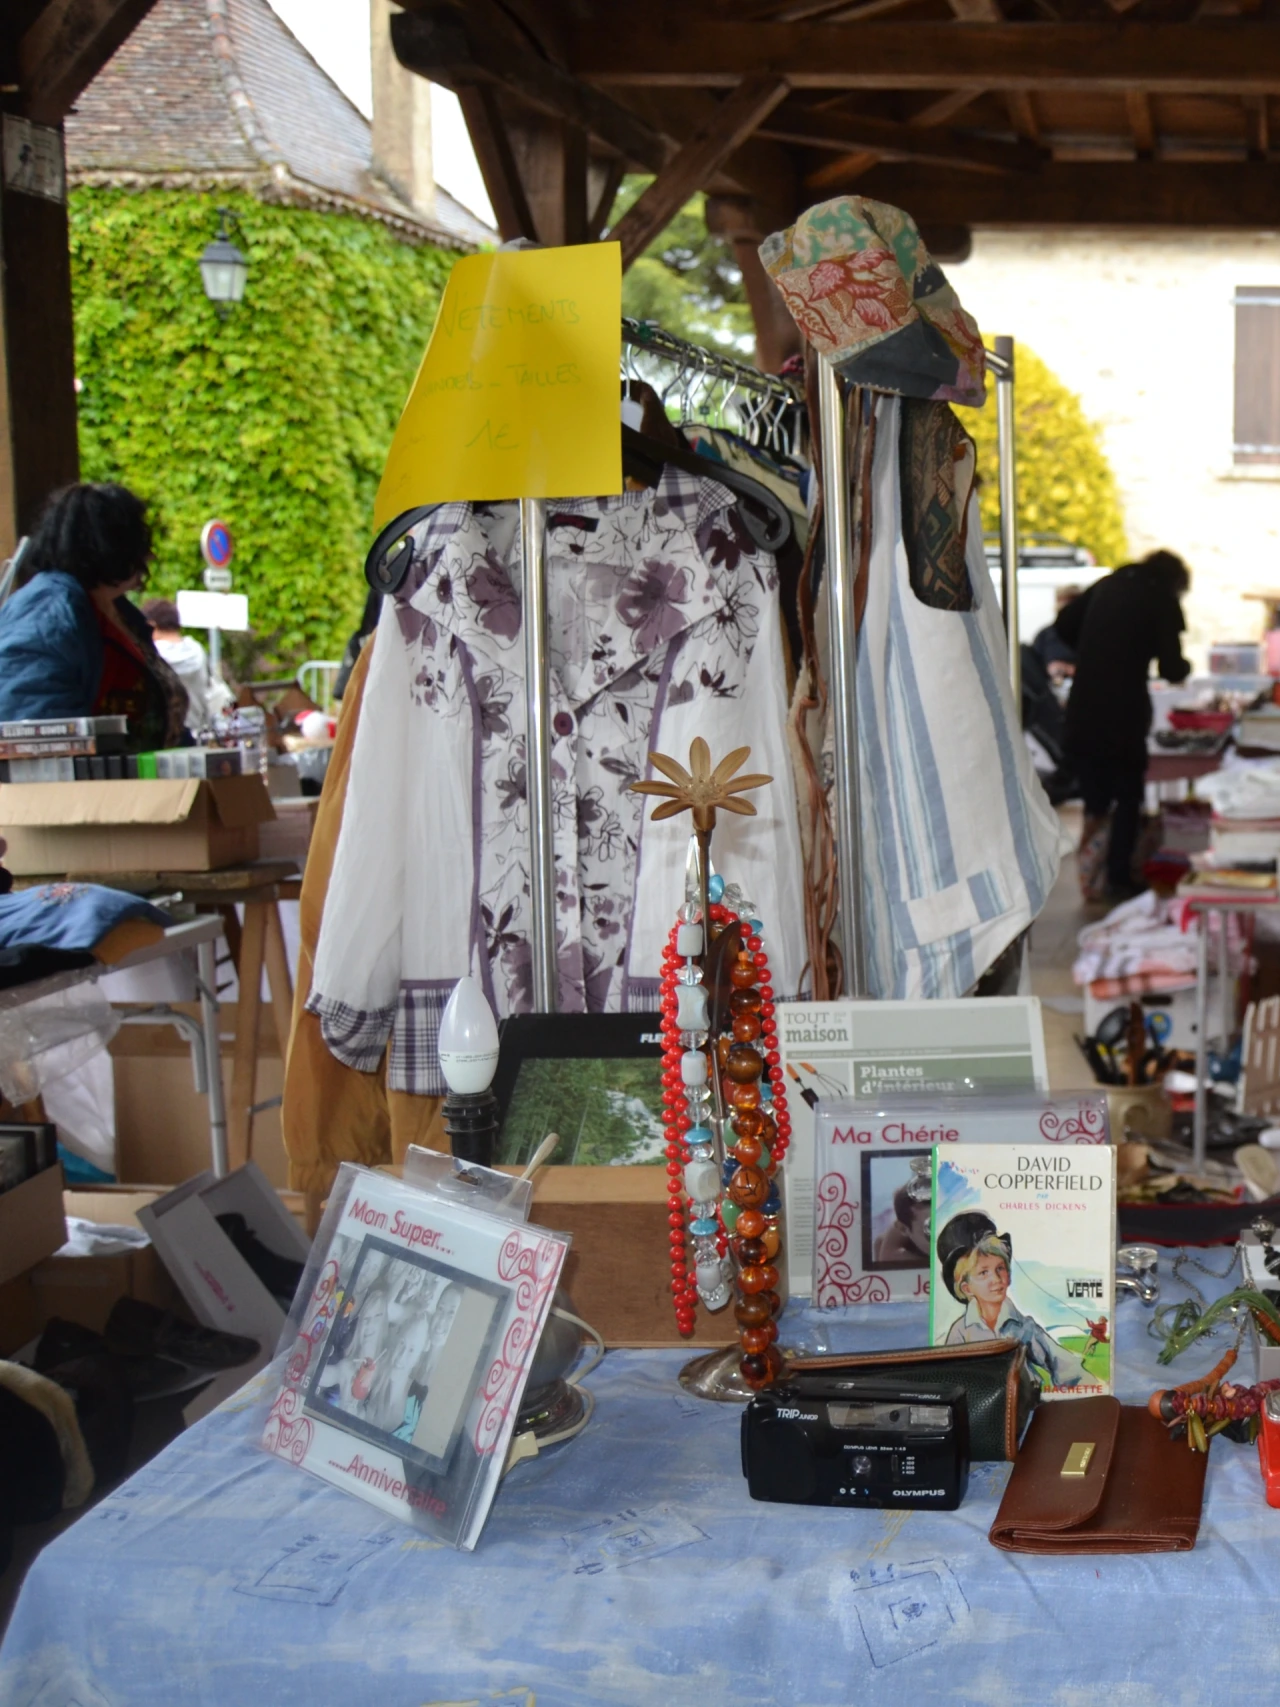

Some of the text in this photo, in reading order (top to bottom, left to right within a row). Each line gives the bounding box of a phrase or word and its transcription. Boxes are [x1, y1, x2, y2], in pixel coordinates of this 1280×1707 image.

[506, 362, 582, 387] TAILLES
[784, 1011, 830, 1024] TOUT
[785, 1025, 849, 1043] maison
[861, 1065, 924, 1079] Plantes
[832, 1122, 959, 1144] Ma Chérie
[1017, 1156, 1071, 1172] DAVID
[984, 1173, 1103, 1191] COPPERFIELD
[348, 1197, 388, 1229] Mon
[999, 1202, 1087, 1211] CHARLES DICKENS
[1066, 1281, 1103, 1298] VERTE
[1043, 1384, 1103, 1394] HACHETTE
[776, 1408, 819, 1421] TRIP JUNIOR
